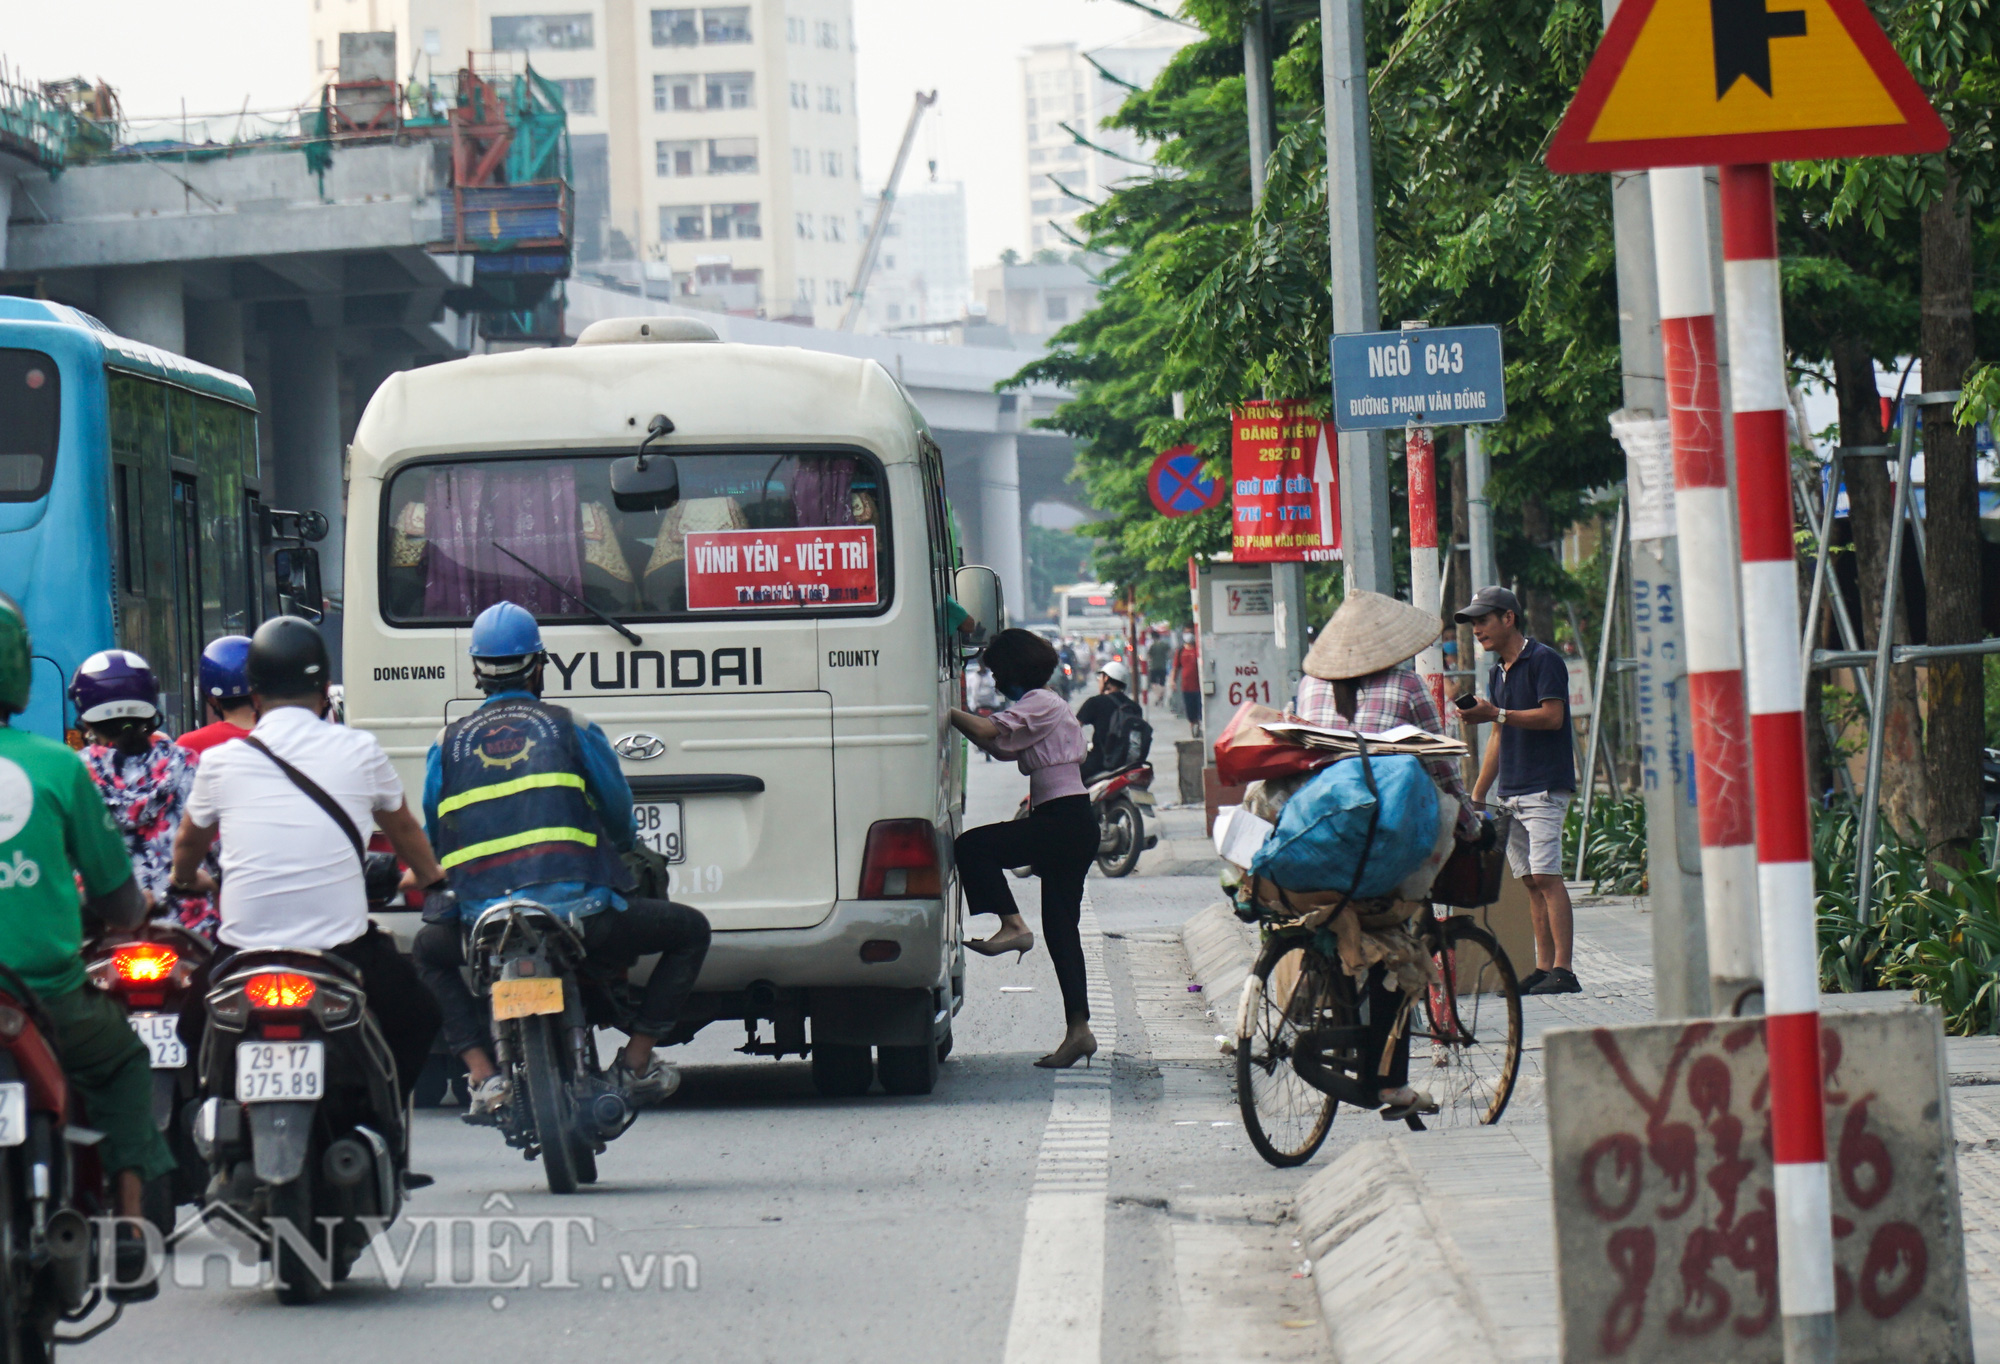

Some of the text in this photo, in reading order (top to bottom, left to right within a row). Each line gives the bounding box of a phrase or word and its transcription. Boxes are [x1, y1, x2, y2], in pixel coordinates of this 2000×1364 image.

[1368, 339, 1463, 378] NGÕ 643
[1350, 387, 1486, 416] ĐƯỜNG PHẠM VĂN ĐỒNG
[1240, 425, 1278, 441] ĐĂNG
[1236, 477, 1260, 495] GIỜ
[1236, 507, 1261, 522] 7H
[1278, 505, 1312, 520] 17H
[1234, 536, 1244, 547] 36
[1246, 535, 1273, 550] PHẠM
[1275, 533, 1293, 547] VĂN
[695, 541, 738, 574] VĨNH
[743, 539, 778, 572] YÊN
[796, 537, 834, 576] VIỆT
[839, 536, 868, 569] TRÌ
[1302, 549, 1342, 562] 100M
[549, 647, 762, 691] YUNDAI
[829, 650, 879, 667] COUNTY
[1229, 680, 1270, 706] 641
[633, 806, 660, 830] 9B
[251, 1046, 310, 1069] 29-Y7
[244, 1072, 317, 1098] 375.89
